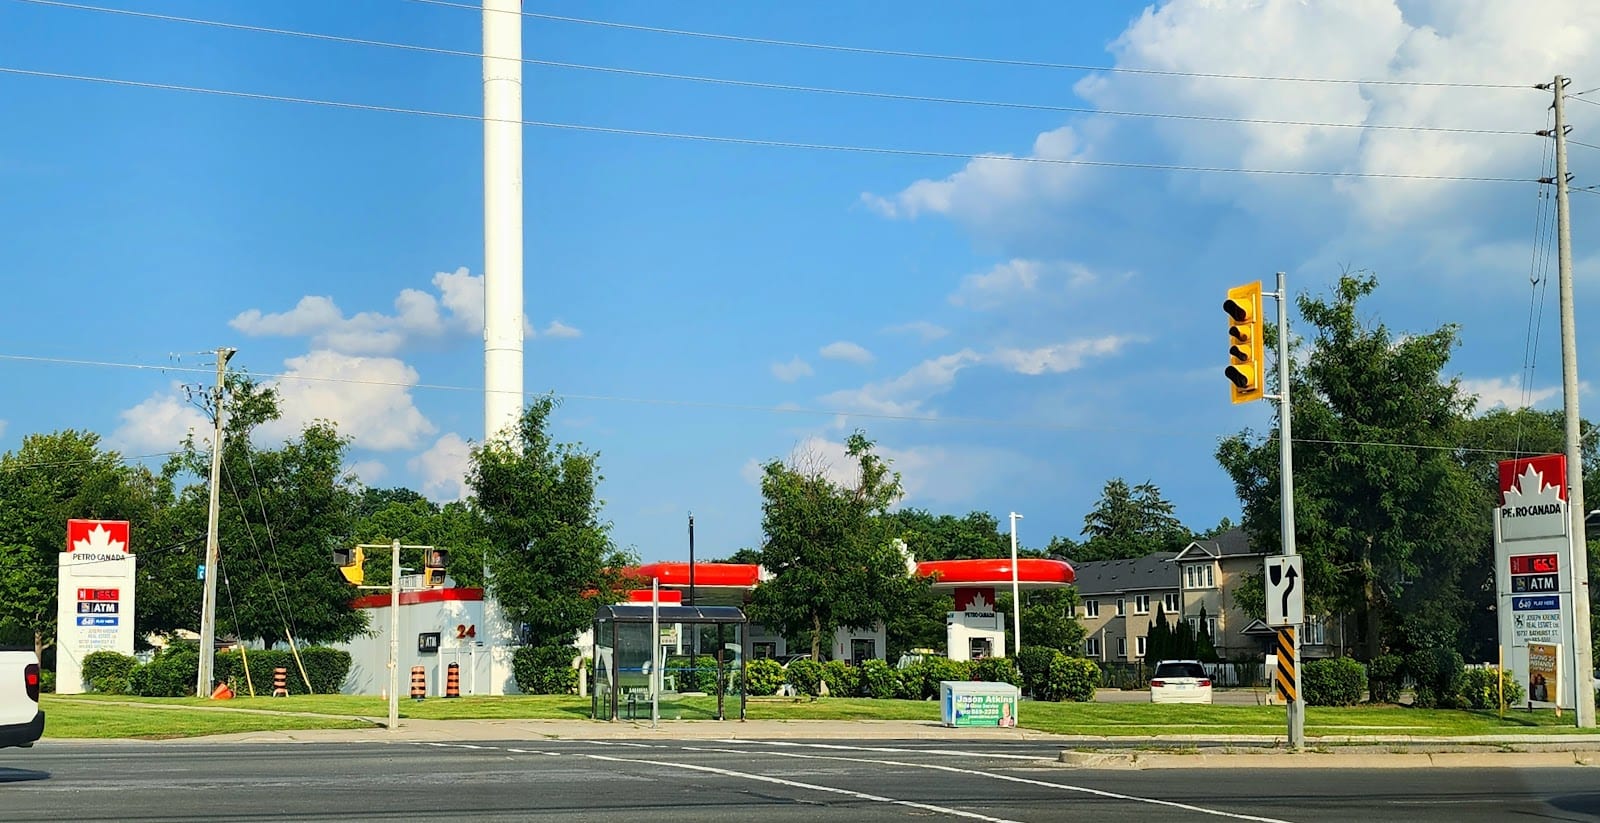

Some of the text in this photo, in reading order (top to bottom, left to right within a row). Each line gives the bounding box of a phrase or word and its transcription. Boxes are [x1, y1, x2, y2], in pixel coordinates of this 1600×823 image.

[1531, 577, 1554, 590] ATM
[94, 603, 115, 613] ATM
[456, 624, 476, 639] 24
[425, 636, 437, 647] ATM
[957, 695, 1014, 704] Jason Atkins
